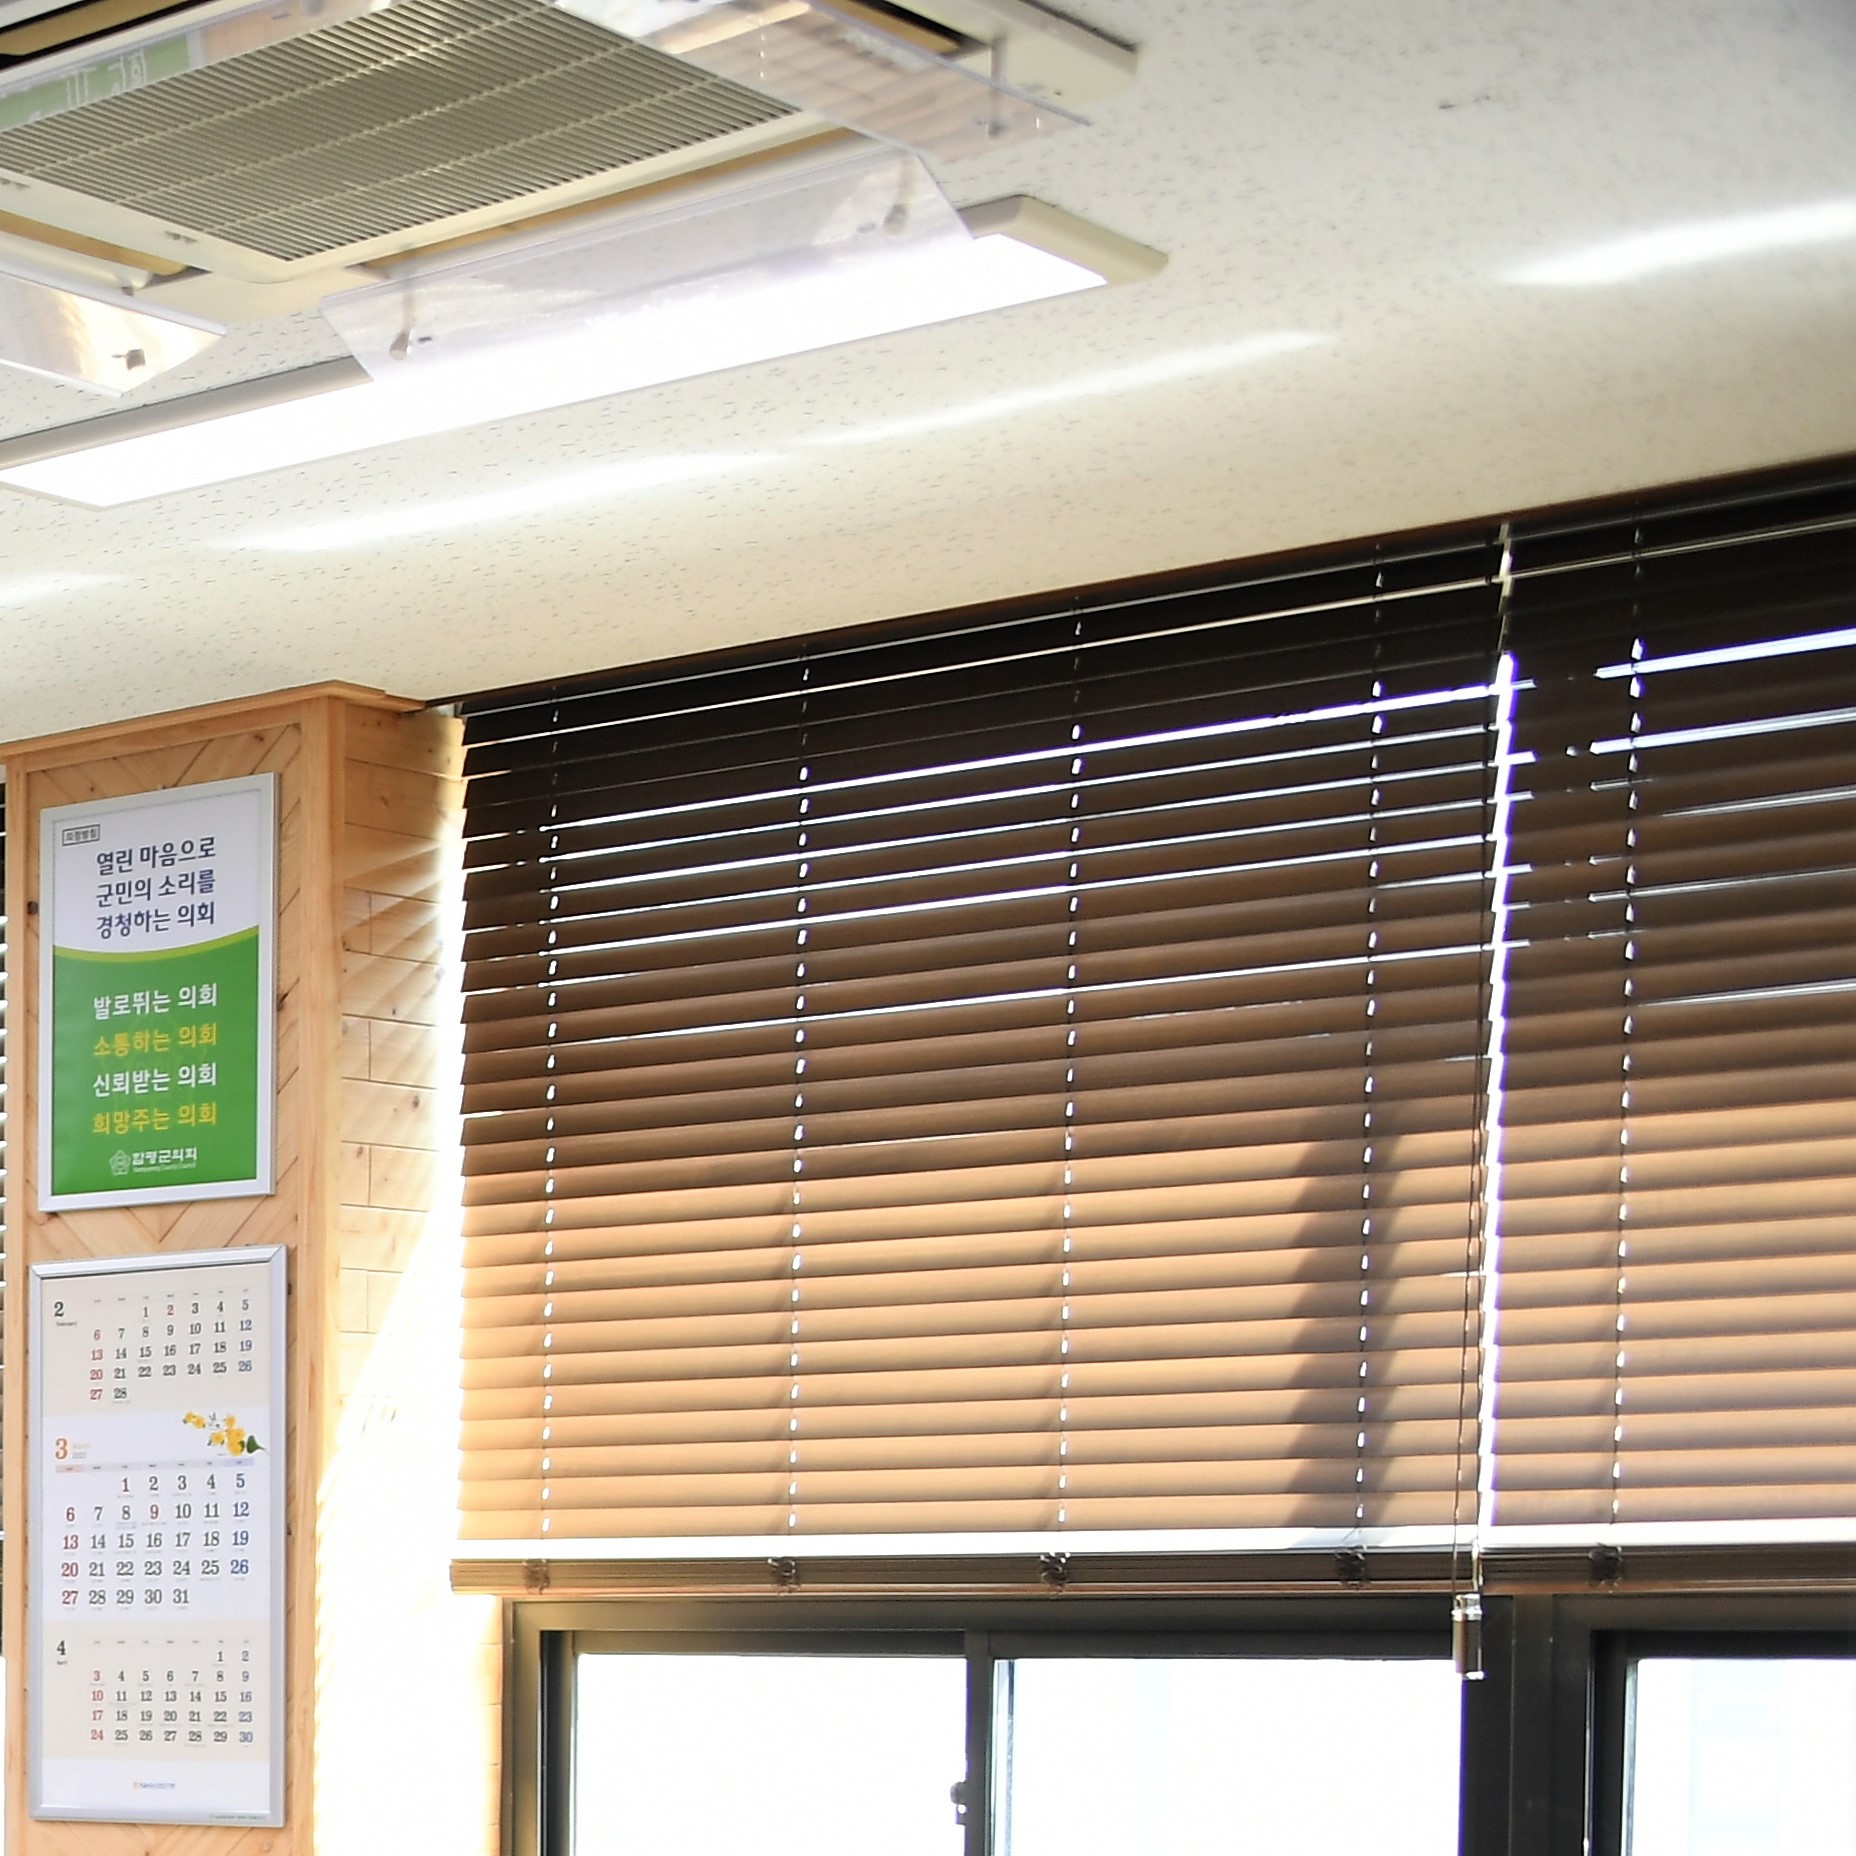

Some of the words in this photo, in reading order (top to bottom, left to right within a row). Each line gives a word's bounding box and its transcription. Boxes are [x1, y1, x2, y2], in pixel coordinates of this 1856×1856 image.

[97, 849, 133, 876] 열린
[140, 837, 216, 868] 마음으로
[96, 877, 152, 908] 군민의
[158, 869, 216, 897] 소리를
[96, 909, 171, 940] 경청하는
[177, 901, 215, 927] 의회
[93, 990, 172, 1021] 발로뛰는
[178, 983, 218, 1009] 의회
[93, 1029, 170, 1057] 소통하는
[178, 1022, 217, 1048] 의회
[93, 1068, 171, 1098] 신뢰받는
[178, 1062, 217, 1088] 의회
[92, 1108, 170, 1135] 희망주는
[178, 1102, 217, 1127] 의회
[54, 1301, 64, 1317] 2
[143, 1307, 149, 1317] 1
[166, 1305, 174, 1315] 2
[191, 1303, 199, 1314] 3
[217, 1301, 224, 1312] 4
[241, 1299, 250, 1310] 5
[93, 1329, 101, 1340] 6
[117, 1328, 126, 1339] 7
[142, 1326, 150, 1337] 8
[166, 1325, 175, 1336] 9
[190, 1323, 201, 1334] 10
[215, 1322, 225, 1333] 11
[240, 1320, 252, 1331] 12
[92, 1349, 103, 1360] 13
[116, 1348, 126, 1359] 14
[140, 1346, 151, 1358] 15
[165, 1345, 176, 1356] 16
[190, 1343, 201, 1355] 17
[215, 1342, 226, 1353] 18
[240, 1340, 252, 1351] 19
[90, 1369, 103, 1380] 20
[114, 1368, 126, 1379] 21
[138, 1366, 151, 1377] 22
[163, 1365, 176, 1376] 23
[188, 1364, 201, 1374] 24
[213, 1362, 227, 1373] 25
[239, 1360, 252, 1372] 26
[90, 1389, 103, 1400] 27
[114, 1388, 127, 1399] 28
[55, 1438, 68, 1459] 3
[122, 1478, 130, 1492] 1
[148, 1476, 159, 1491] 2
[177, 1475, 187, 1490] 3
[206, 1475, 216, 1489] 4
[235, 1473, 246, 1488] 5
[65, 1507, 76, 1521] 6
[94, 1507, 103, 1520] 7
[121, 1505, 131, 1520] 8
[149, 1505, 159, 1519] 9
[176, 1504, 191, 1518] 10
[205, 1503, 219, 1518] 11
[234, 1502, 249, 1517] 12
[63, 1535, 78, 1549] 13
[92, 1535, 105, 1549] 14
[119, 1534, 134, 1548] 15
[147, 1533, 162, 1547] 16
[176, 1532, 191, 1547] 17
[204, 1531, 219, 1546] 18
[233, 1531, 248, 1545] 19
[62, 1563, 78, 1577] 20
[89, 1562, 105, 1576] 21
[116, 1561, 134, 1576] 22
[145, 1561, 162, 1575] 23
[173, 1561, 190, 1575] 24
[202, 1560, 219, 1575] 25
[231, 1559, 248, 1574] 26
[62, 1590, 78, 1604] 27
[89, 1590, 106, 1604] 28
[117, 1590, 134, 1604] 29
[145, 1589, 162, 1604] 30
[173, 1589, 189, 1603] 31
[57, 1640, 66, 1655] 4
[217, 1651, 224, 1662] 1
[241, 1651, 250, 1662] 2
[93, 1671, 101, 1681] 3
[117, 1671, 125, 1681] 4
[142, 1671, 150, 1681] 5
[166, 1671, 175, 1682] 6
[191, 1671, 199, 1681] 7
[216, 1671, 224, 1682] 8
[241, 1671, 250, 1682] 9
[92, 1690, 103, 1701] 10
[117, 1691, 126, 1701] 11
[141, 1691, 152, 1701] 12
[165, 1691, 177, 1702] 13
[190, 1691, 201, 1702] 14
[215, 1691, 227, 1702] 15
[240, 1691, 252, 1702] 16
[93, 1710, 103, 1721] 17
[117, 1710, 127, 1721] 18
[141, 1710, 152, 1721] 19
[164, 1711, 177, 1721] 20
[189, 1711, 201, 1722] 21
[214, 1711, 227, 1722] 22
[239, 1711, 252, 1722] 23
[91, 1730, 103, 1740] 24
[115, 1730, 128, 1740] 25
[139, 1730, 153, 1741] 26
[164, 1731, 177, 1741] 27
[189, 1731, 202, 1742] 28
[214, 1731, 227, 1742] 29
[239, 1731, 253, 1743] 30
